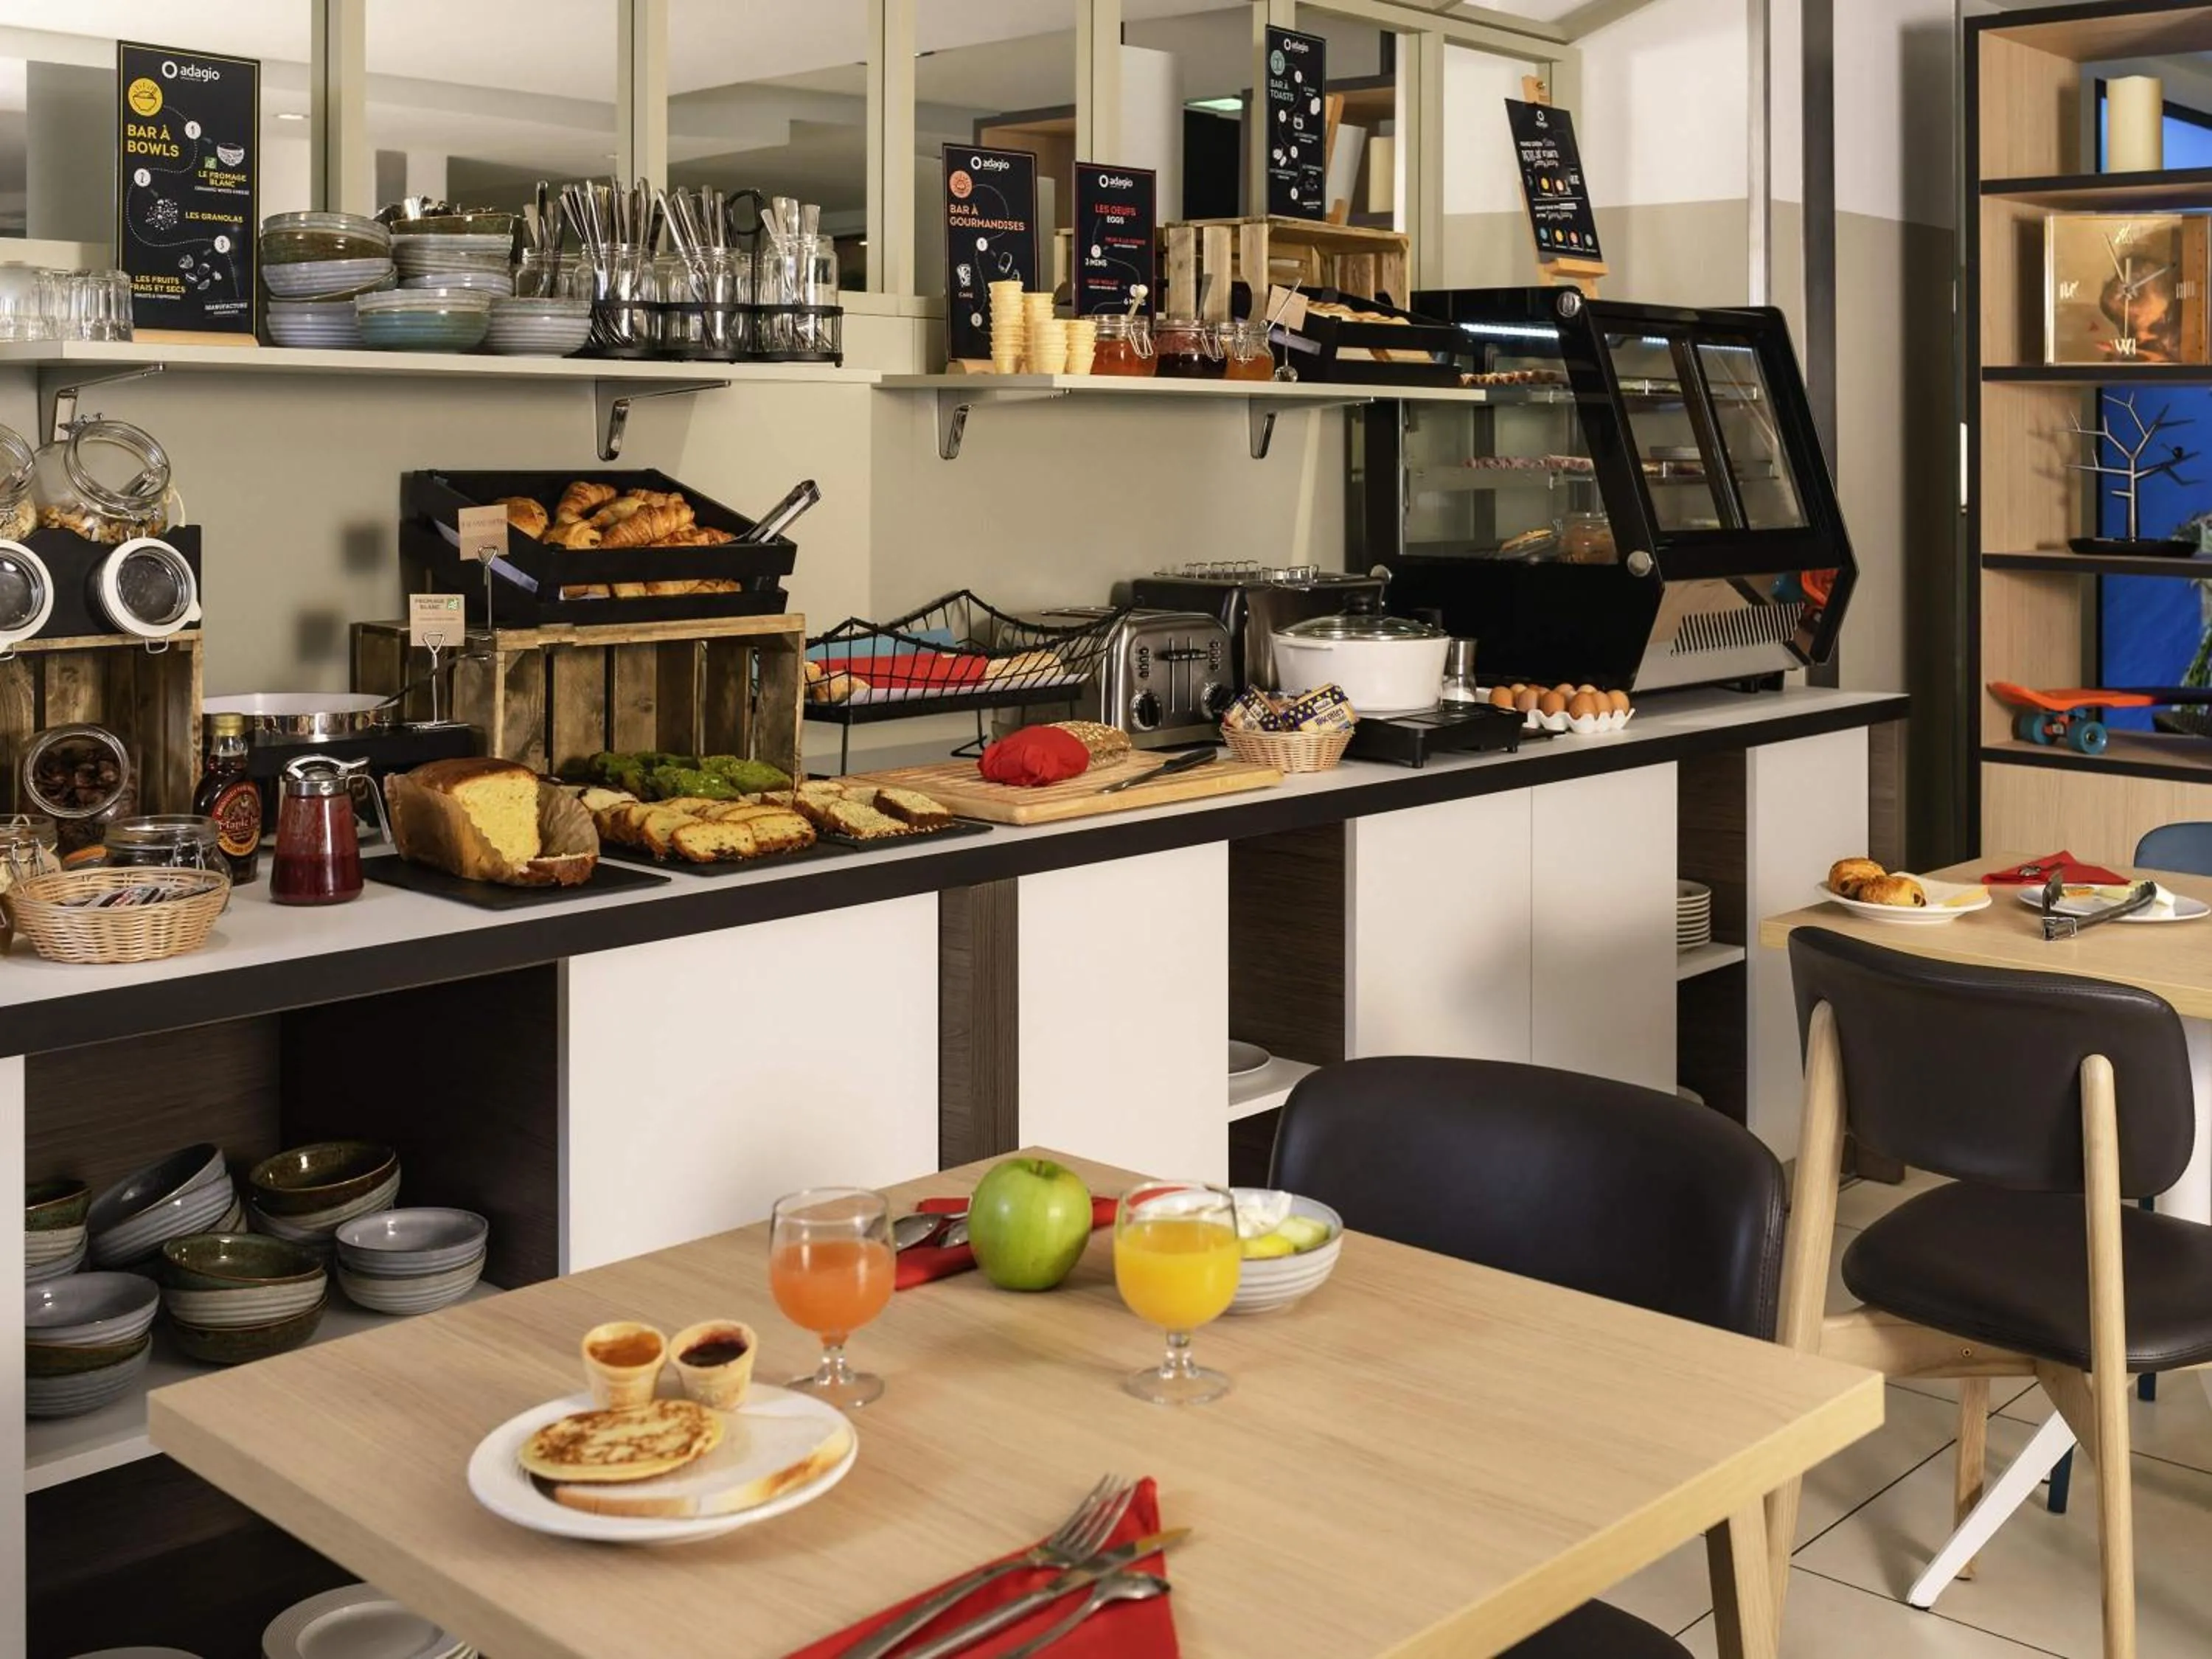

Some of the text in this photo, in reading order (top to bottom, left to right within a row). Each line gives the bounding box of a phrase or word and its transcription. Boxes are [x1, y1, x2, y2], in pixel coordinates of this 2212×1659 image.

[180, 64, 220, 82] adagio
[128, 123, 170, 141] BAR À
[128, 140, 180, 157] BOWLS
[198, 170, 248, 182] LE FROMAGE
[209, 179, 236, 188] BLANC
[949, 204, 970, 215] BAR
[185, 212, 243, 223] LES GRANOLAS
[949, 216, 1026, 231] GOURMANDISES
[151, 276, 180, 285] FRUITS
[154, 285, 164, 293] ET
[165, 285, 186, 293] SECS
